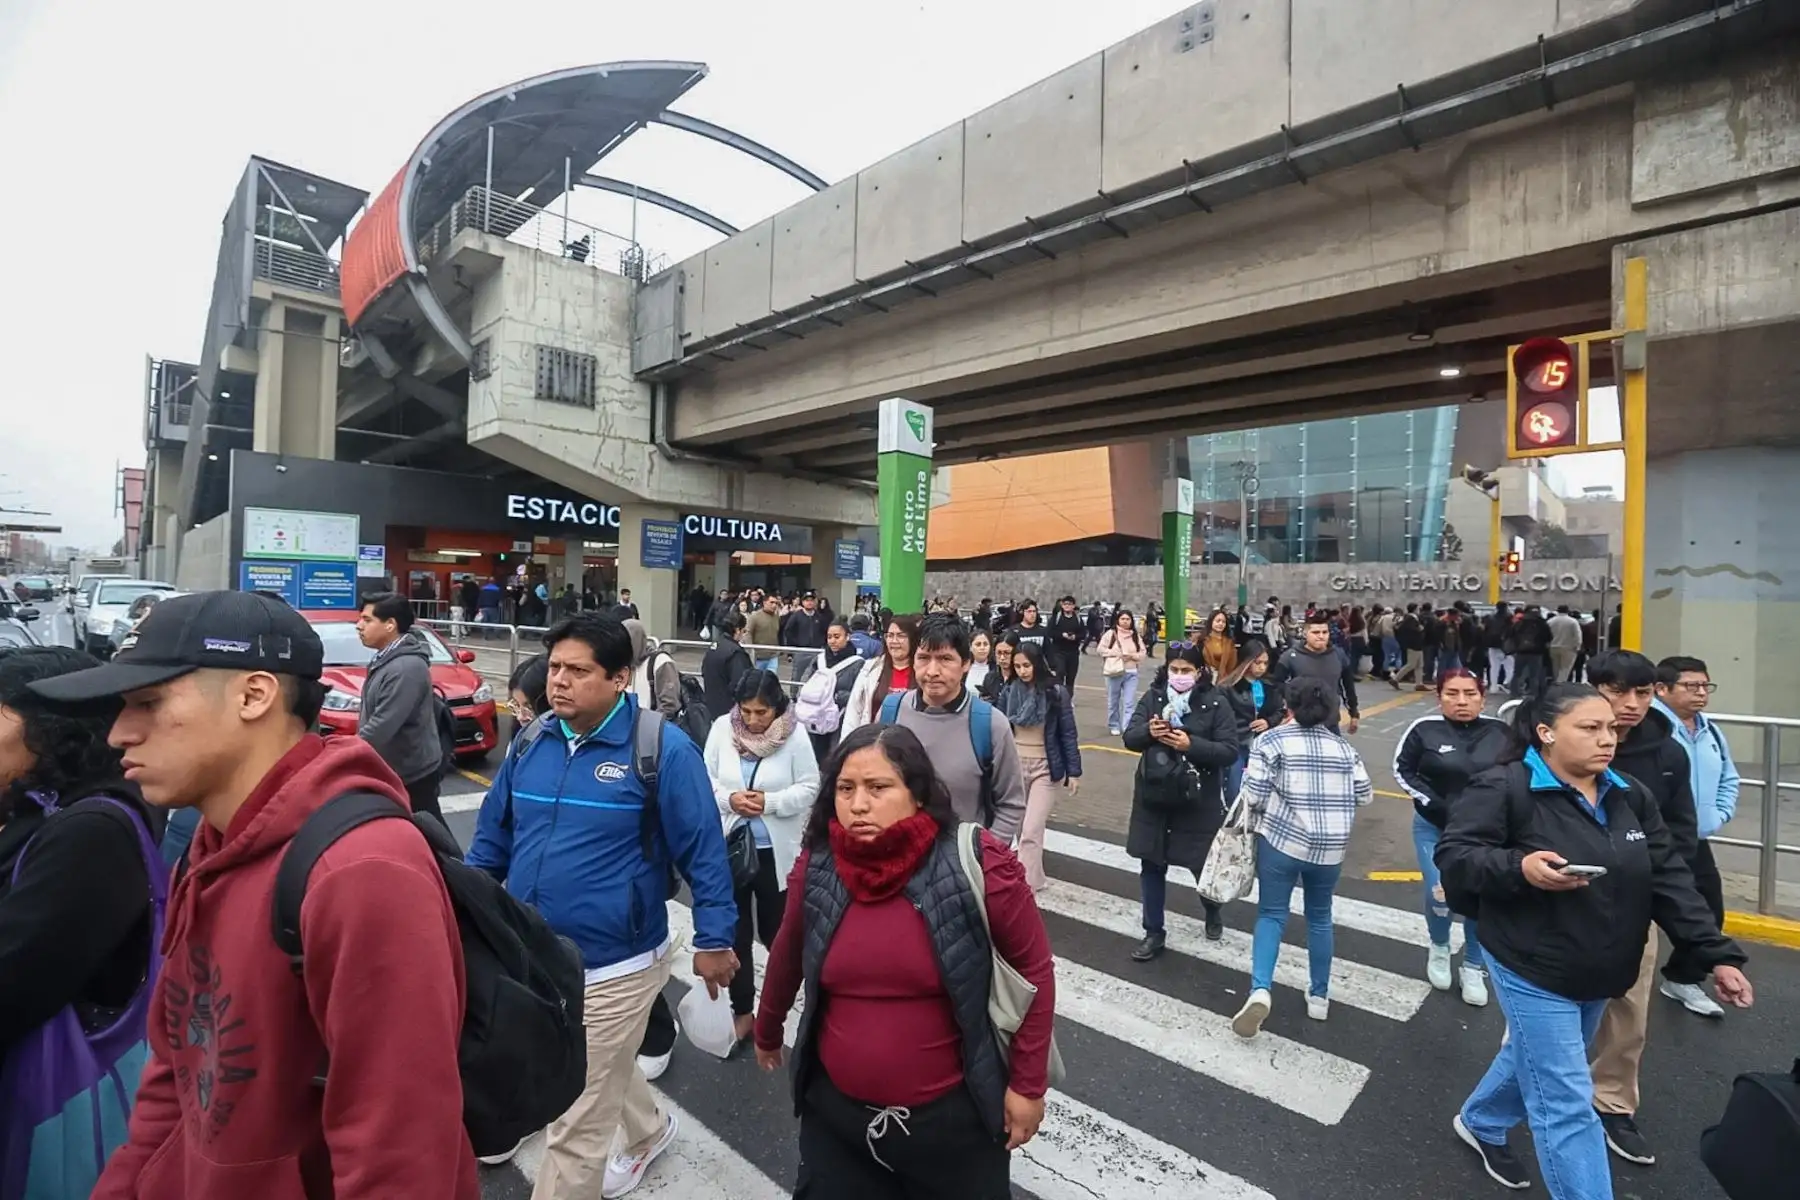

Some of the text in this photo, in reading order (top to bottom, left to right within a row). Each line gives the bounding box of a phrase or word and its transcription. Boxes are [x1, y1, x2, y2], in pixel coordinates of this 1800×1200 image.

[1541, 361, 1568, 387] 15
[902, 490, 915, 552] Metro
[914, 470, 927, 554] de Lima
[684, 514, 782, 541] CULTURA
[1330, 574, 1392, 591] GRAN
[1399, 572, 1482, 592] TEATRO
[598, 766, 626, 779] Elite
